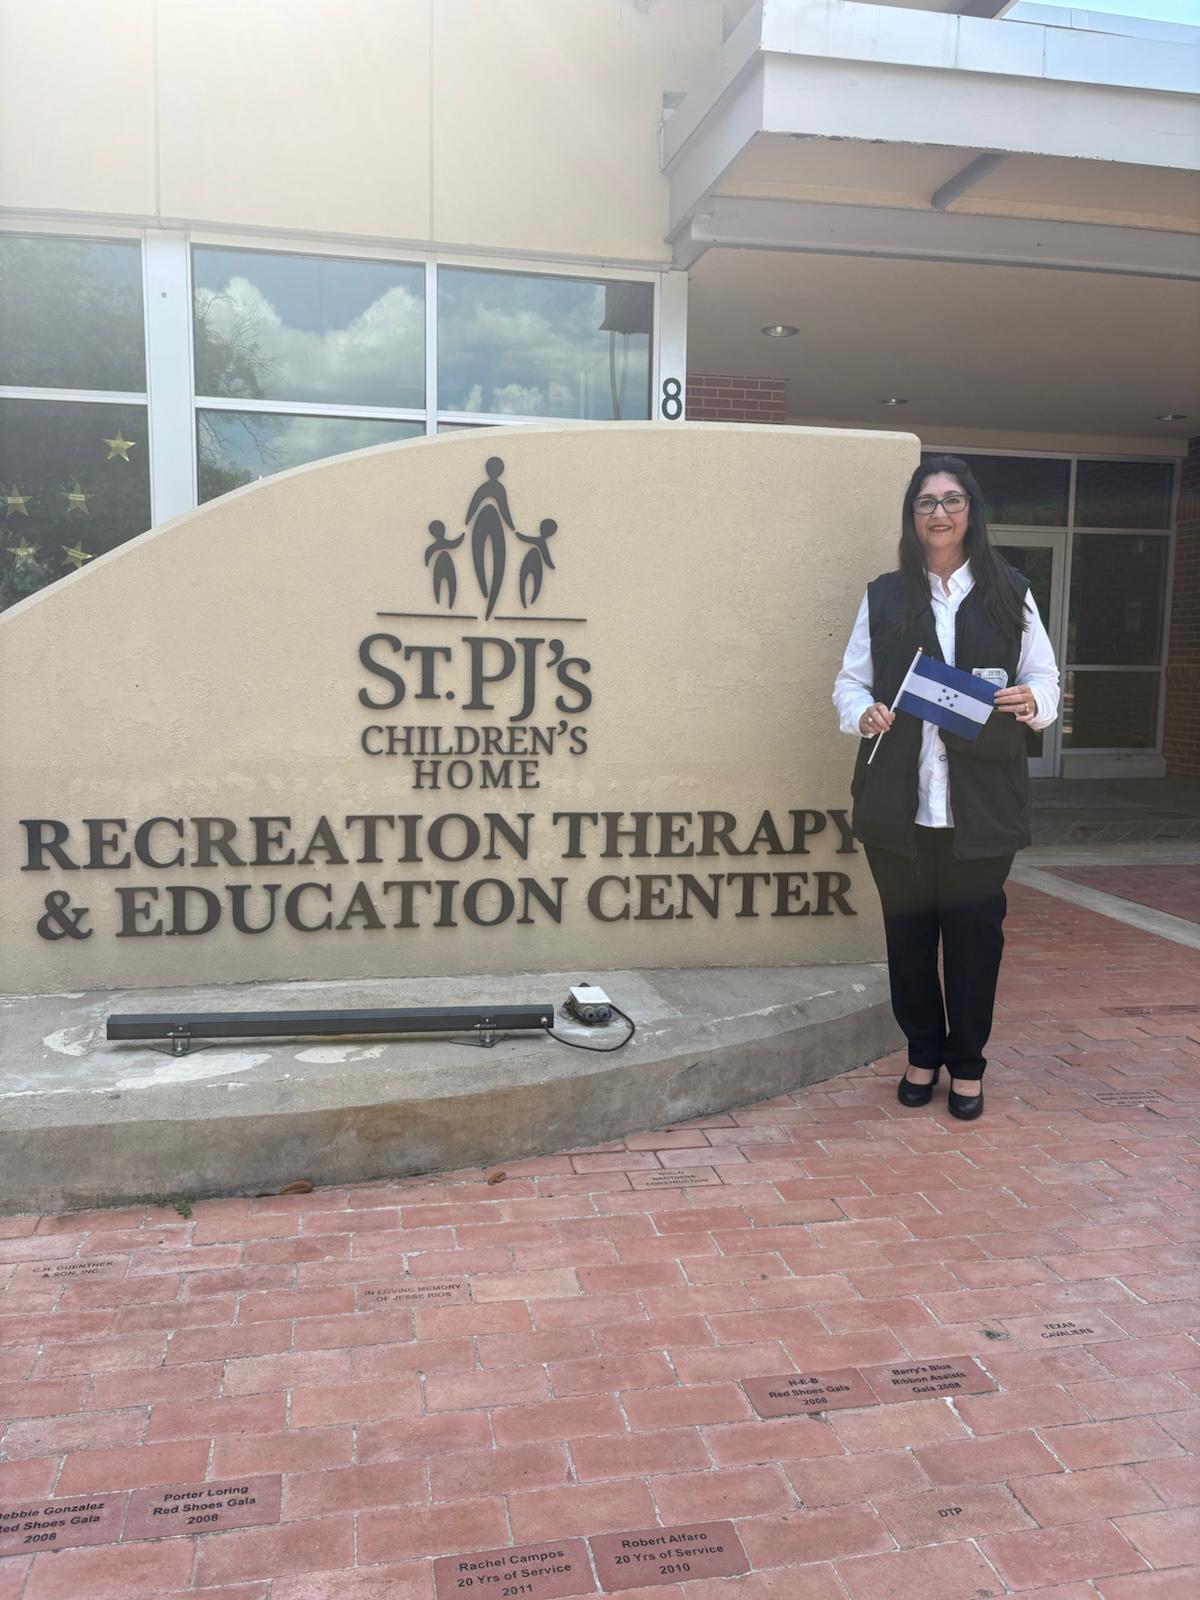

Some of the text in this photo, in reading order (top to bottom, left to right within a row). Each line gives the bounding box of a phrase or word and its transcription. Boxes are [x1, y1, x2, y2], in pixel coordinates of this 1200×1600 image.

[661, 377, 683, 421] 8
[360, 720, 588, 756] CHILDREN'S
[412, 759, 541, 790] HOME
[19, 808, 858, 871] RECREATION THERAPY
[36, 871, 858, 941] & EDUCATION CENTER
[56, 1261, 113, 1270] GUENTHER
[377, 1287, 415, 1295] LOVING
[418, 1283, 461, 1292] MEMORY
[428, 1291, 452, 1299] RIOS
[1041, 1328, 1094, 1338] CAVALIERS
[892, 1363, 952, 1377] Barry's Blue
[892, 1371, 966, 1386] Ribbon Assists
[769, 1383, 850, 1399] Red Shoes Gala
[912, 1381, 962, 1394] Gala 2008
[164, 1485, 249, 1502] Porter Loring
[0, 1502, 105, 1520] ebbie Gonzalez
[153, 1496, 256, 1515] Red Shoes Gala
[938, 1507, 962, 1517] DTP
[0, 1515, 101, 1533] ed Shoes Gala
[187, 1513, 219, 1525] 2008
[23, 1532, 57, 1544] 2008
[621, 1531, 708, 1550] Robert Alfaro
[459, 1550, 564, 1572] Rachel Campos
[614, 1543, 724, 1565] 20 Yrs of Service
[457, 1563, 572, 1588] 20 Yrs of Service
[659, 1562, 691, 1575] 2010
[502, 1583, 533, 1597] 2011
